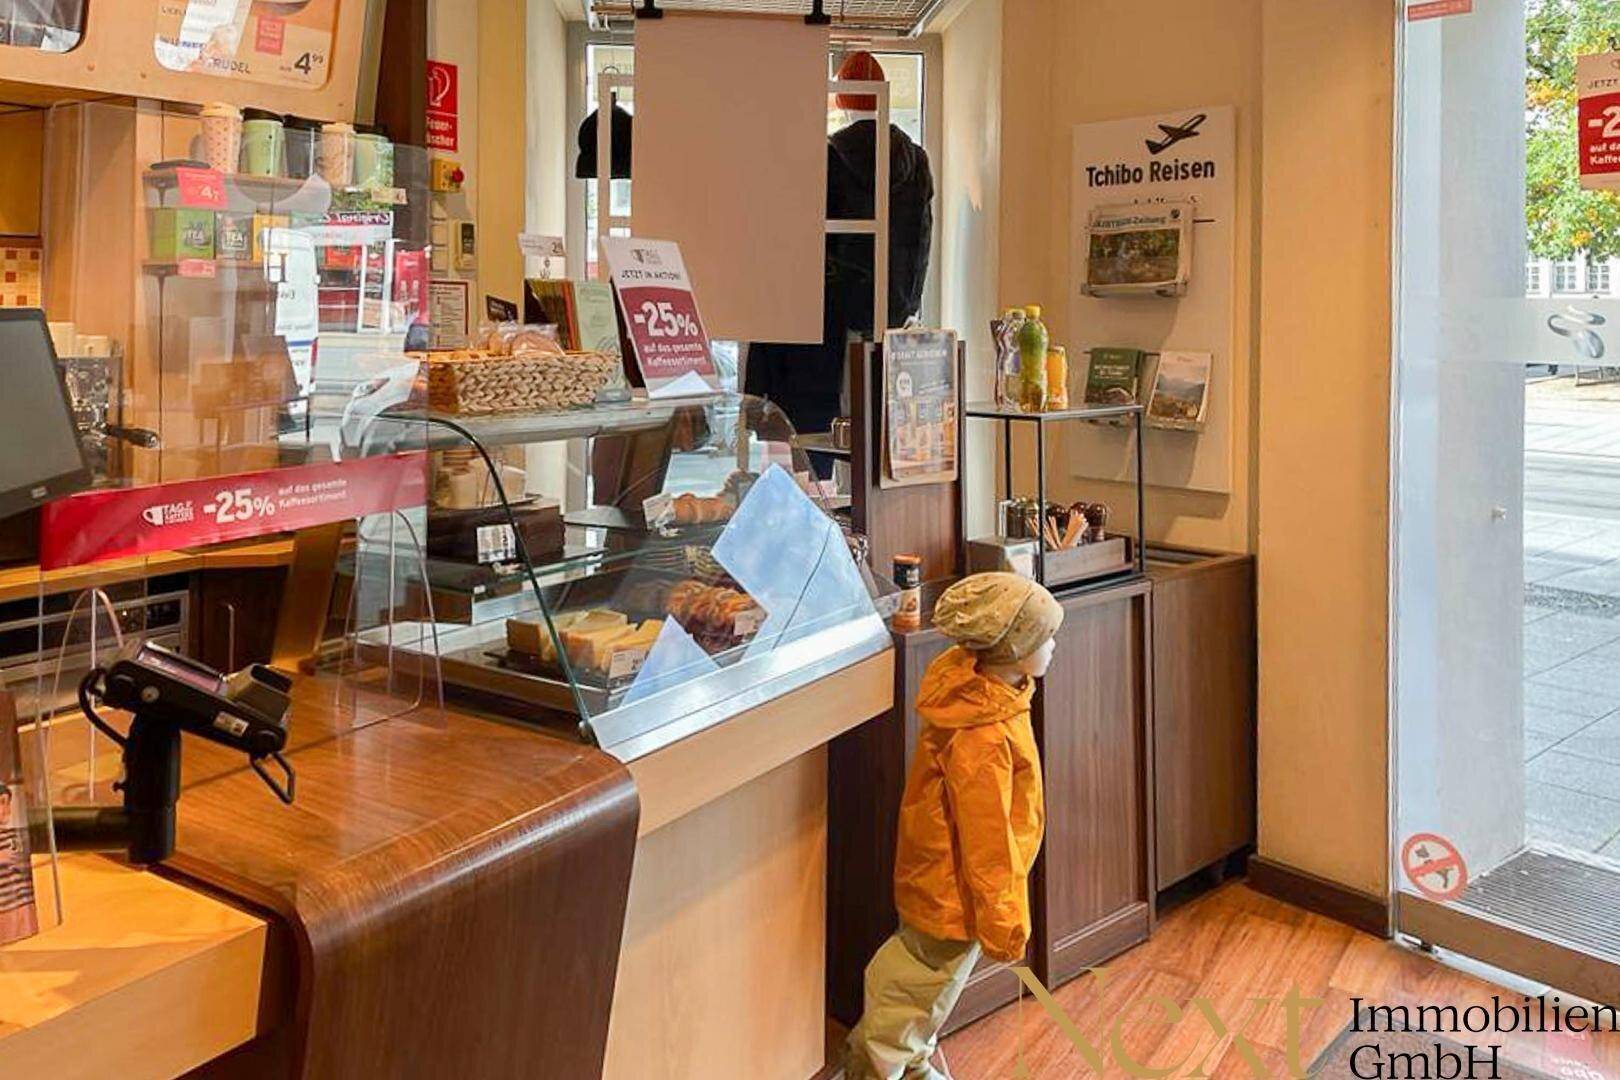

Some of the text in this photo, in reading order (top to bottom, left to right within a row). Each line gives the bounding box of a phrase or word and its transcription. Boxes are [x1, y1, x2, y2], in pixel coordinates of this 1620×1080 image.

[1086, 158, 1215, 187] Tchibo Reisen
[1590, 154, 1620, 165] Kaffe
[633, 301, 699, 337] -25%
[203, 488, 275, 524] -25%
